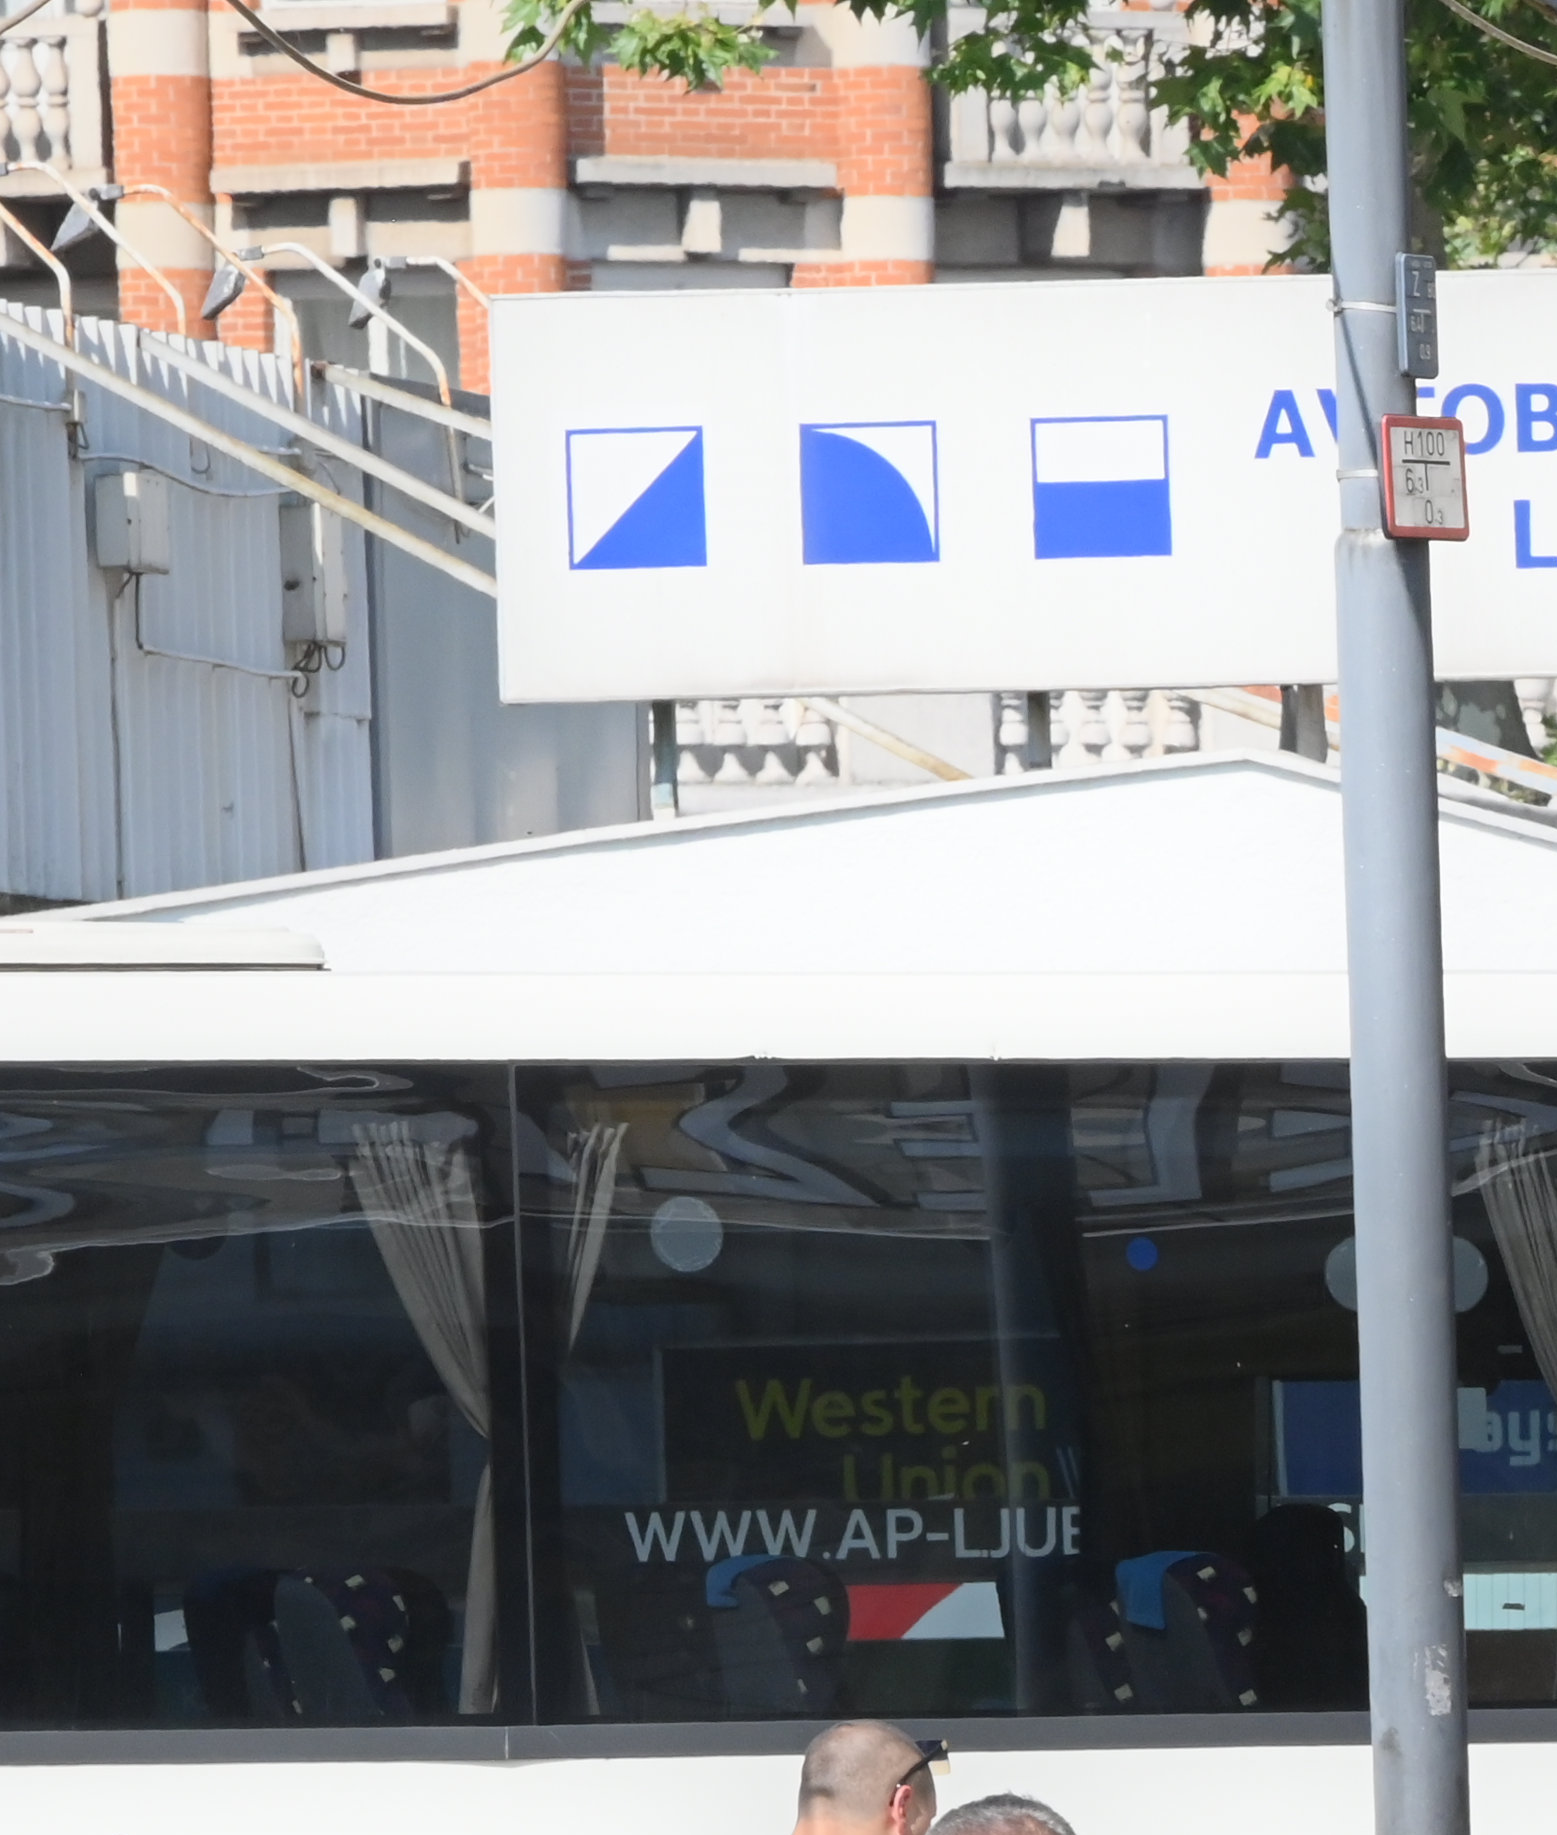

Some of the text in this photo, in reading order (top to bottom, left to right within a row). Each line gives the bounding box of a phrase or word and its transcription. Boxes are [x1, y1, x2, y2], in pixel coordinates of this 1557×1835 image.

[1403, 430, 1445, 457] H100
[735, 1375, 1047, 1441] Western
[842, 1446, 1050, 1500] Union
